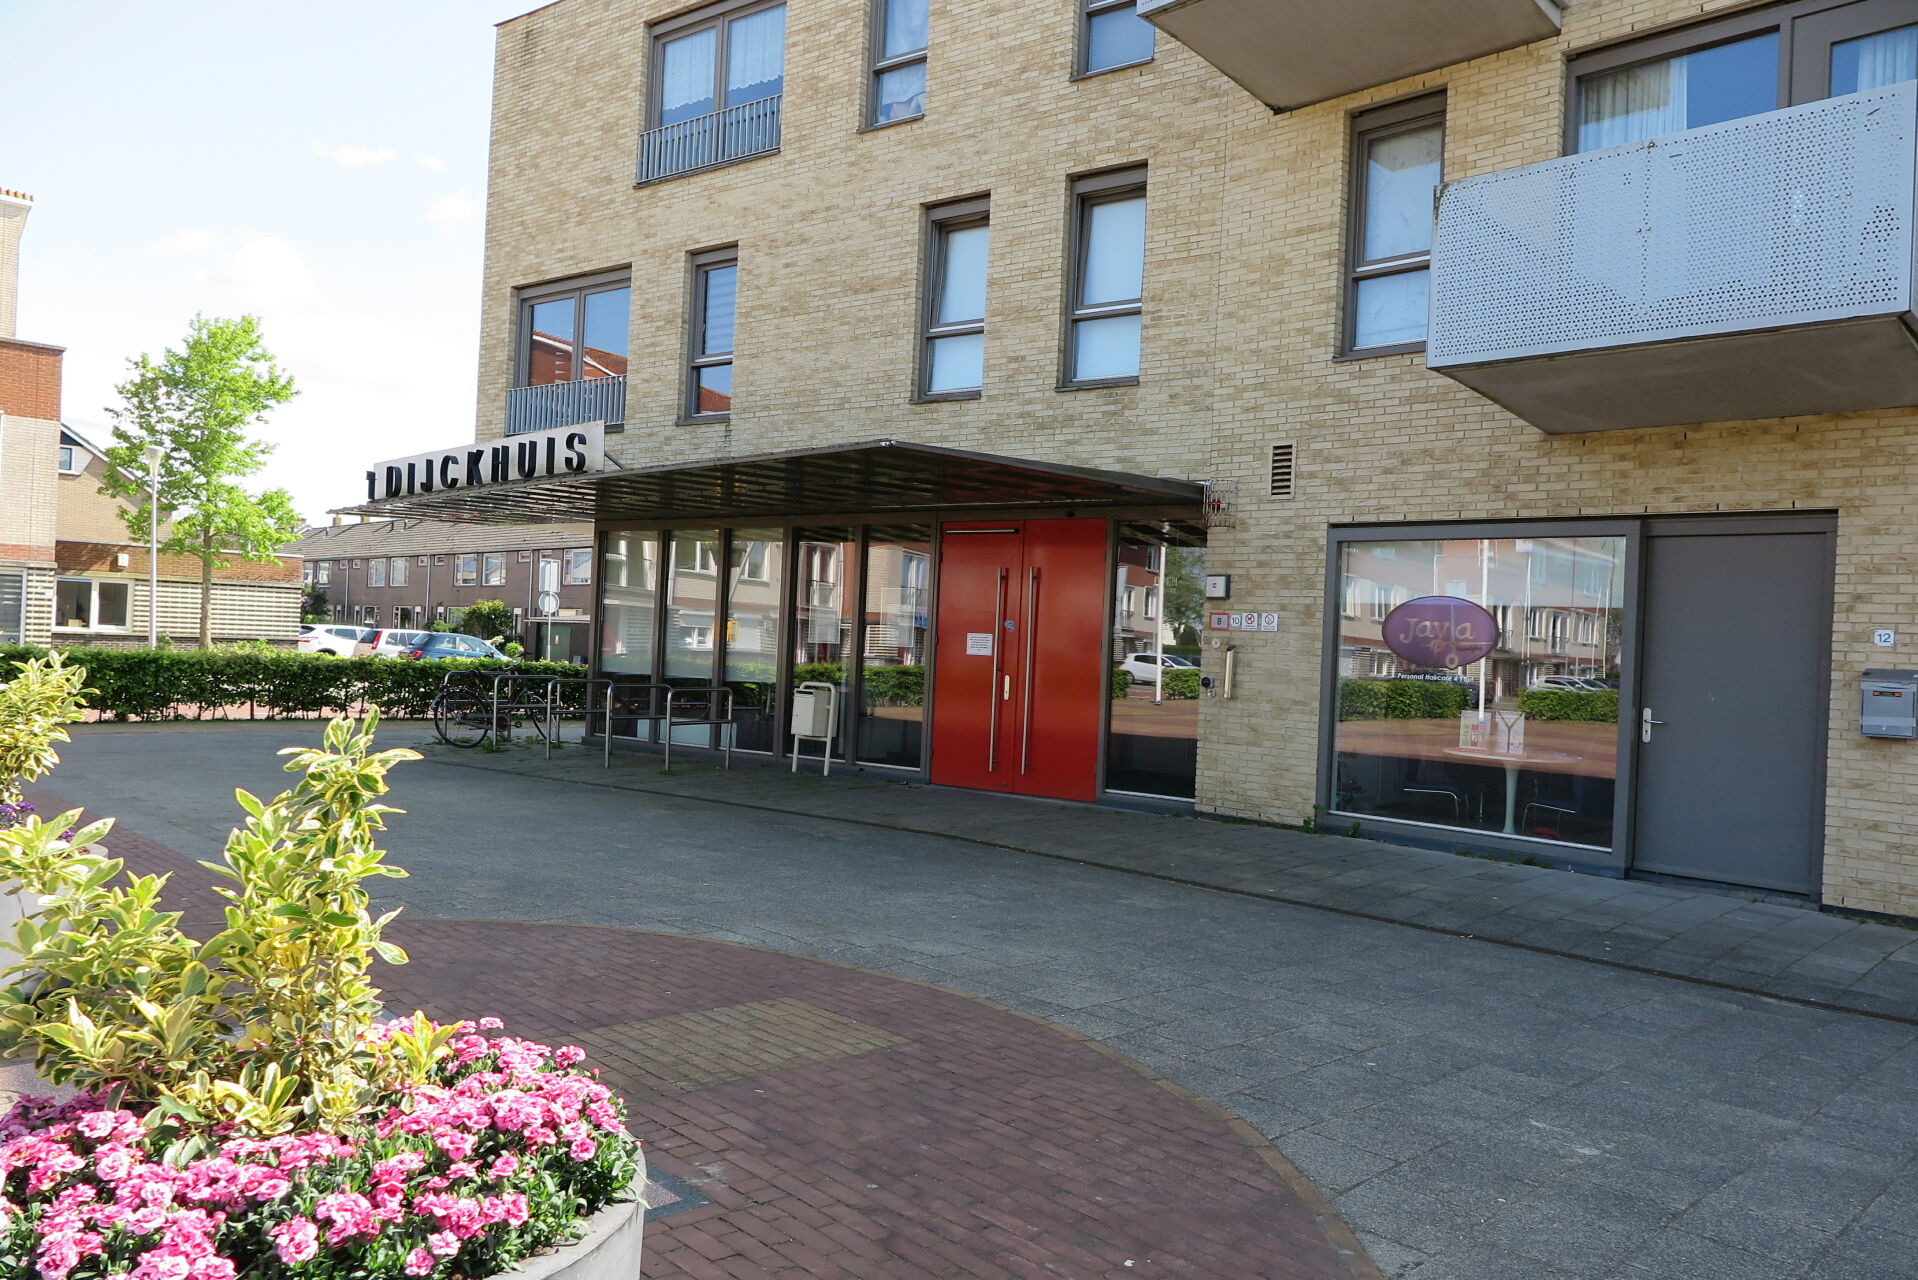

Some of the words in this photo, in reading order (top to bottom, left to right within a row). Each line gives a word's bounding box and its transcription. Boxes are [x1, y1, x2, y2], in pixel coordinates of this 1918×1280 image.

[1232, 617, 1240, 625] 10
[1877, 633, 1891, 643] 12
[1397, 672, 1424, 680] Personal
